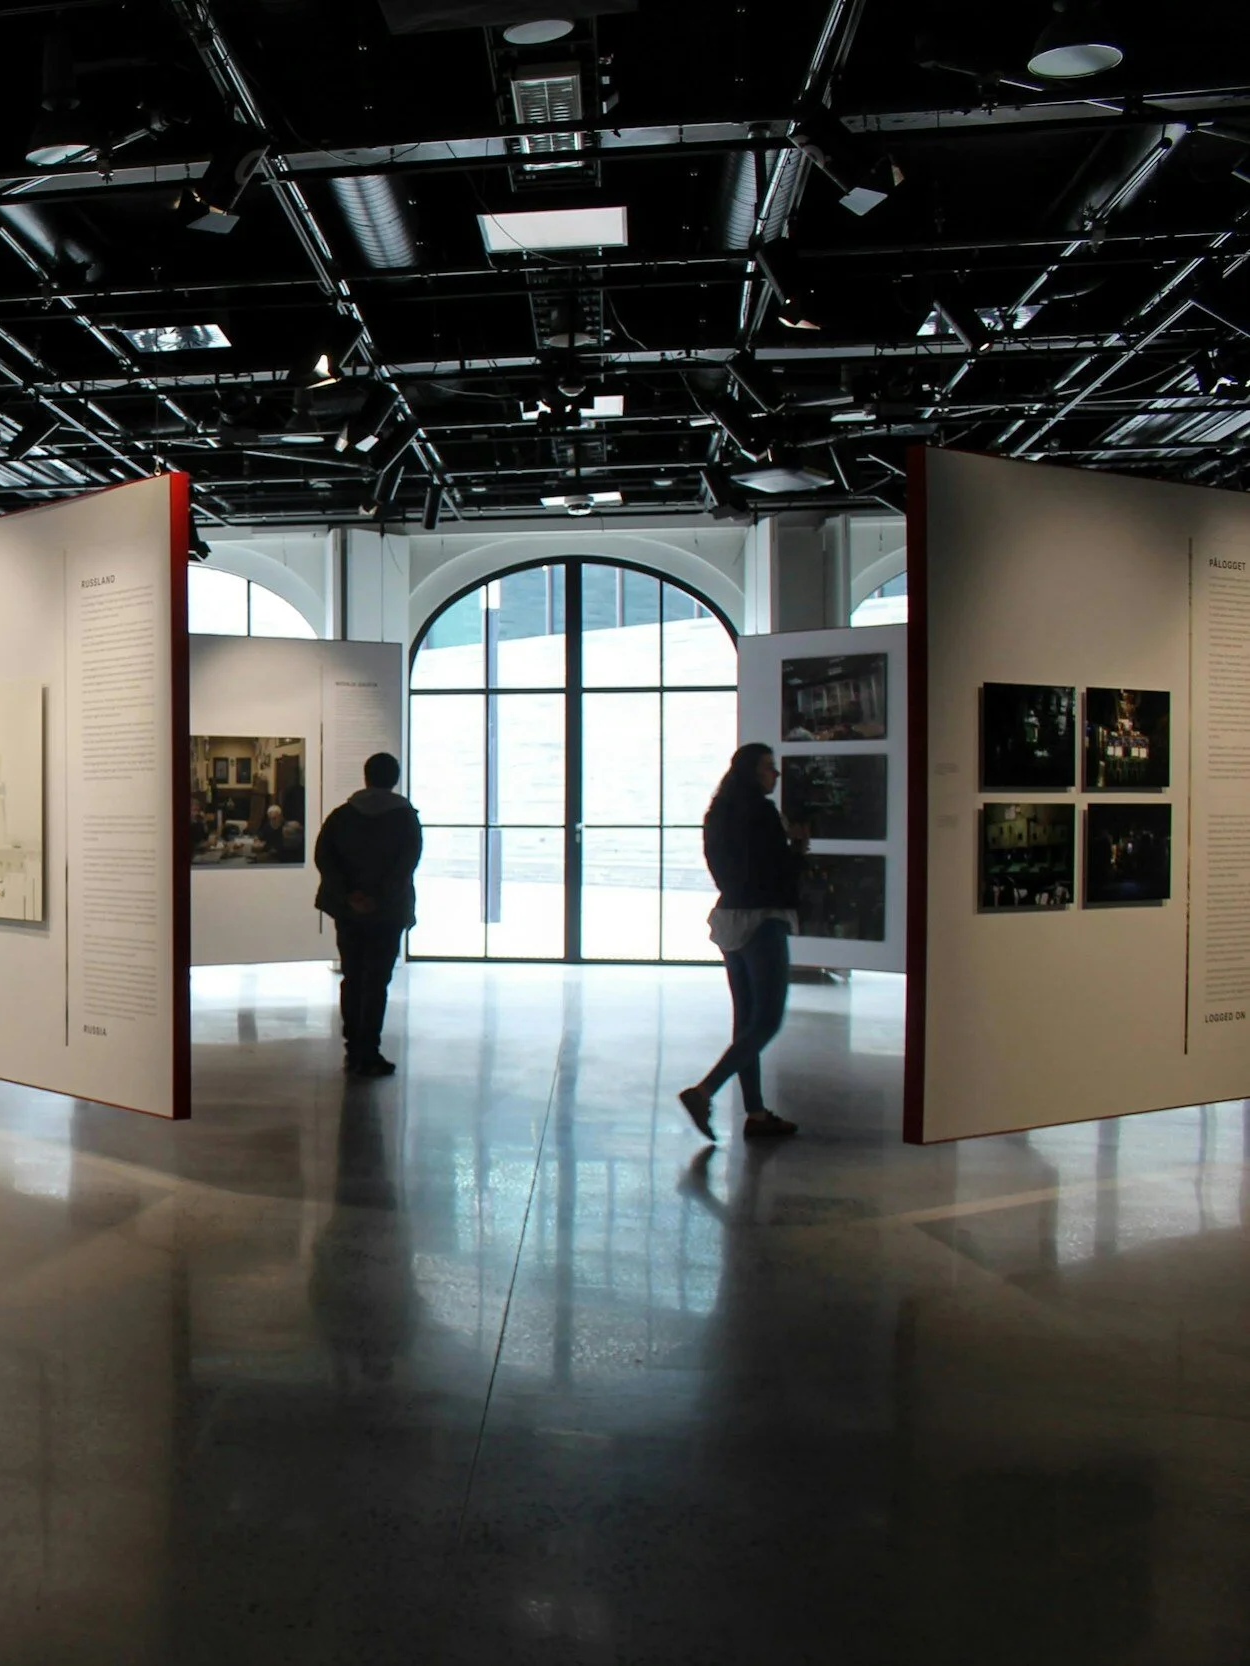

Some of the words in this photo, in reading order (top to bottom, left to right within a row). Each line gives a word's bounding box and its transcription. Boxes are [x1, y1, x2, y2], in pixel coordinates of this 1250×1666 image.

[1209, 556, 1246, 570] PÅLOGGET
[81, 574, 116, 588] RUSSLAND
[1204, 1012, 1234, 1023] LOGGED
[1235, 1010, 1246, 1020] ON
[83, 1024, 108, 1037] RUSSIA
